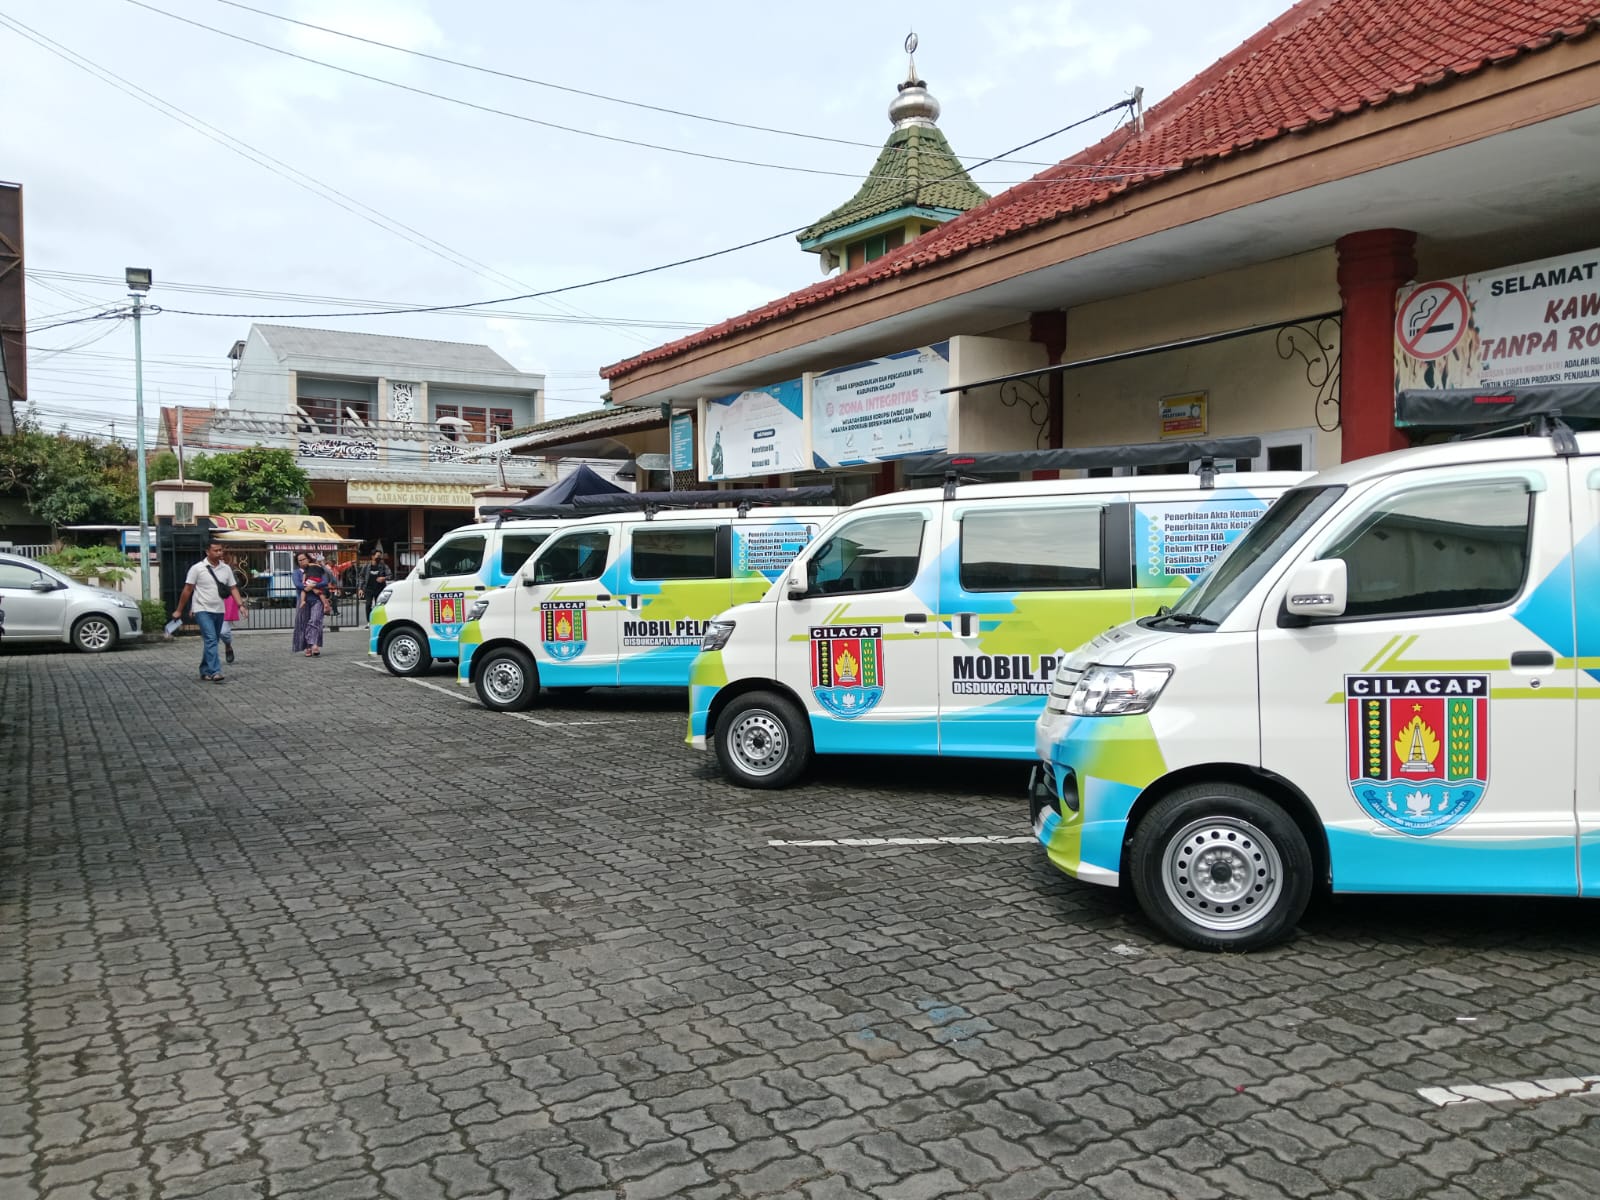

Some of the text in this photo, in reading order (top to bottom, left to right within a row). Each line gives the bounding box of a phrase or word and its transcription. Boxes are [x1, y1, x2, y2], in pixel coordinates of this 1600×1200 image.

[1491, 262, 1598, 296] SELAMAT
[1481, 329, 1558, 361] TANPA
[1564, 358, 1590, 368] ADALAH
[1502, 377, 1530, 388] KEGIATAN
[1564, 368, 1600, 380] PENJUALAN
[839, 388, 918, 416] ZONA INTEGRITAS
[350, 481, 391, 491] SOTO
[1164, 512, 1209, 521] Penerbitan
[1230, 510, 1263, 518] Kemati
[1164, 522, 1209, 532] Penerbitan
[1230, 521, 1251, 529] Kela
[1164, 534, 1209, 542] Penerbitan
[1211, 544, 1229, 552] Elek
[624, 622, 672, 636] MOBIL
[813, 628, 878, 638] CILACAP
[624, 638, 670, 646] DISDUKCAPIL
[954, 656, 1063, 680] MOBIL P
[954, 682, 1028, 695] DISDUKCAPIL
[1353, 679, 1482, 694] CILACAP
